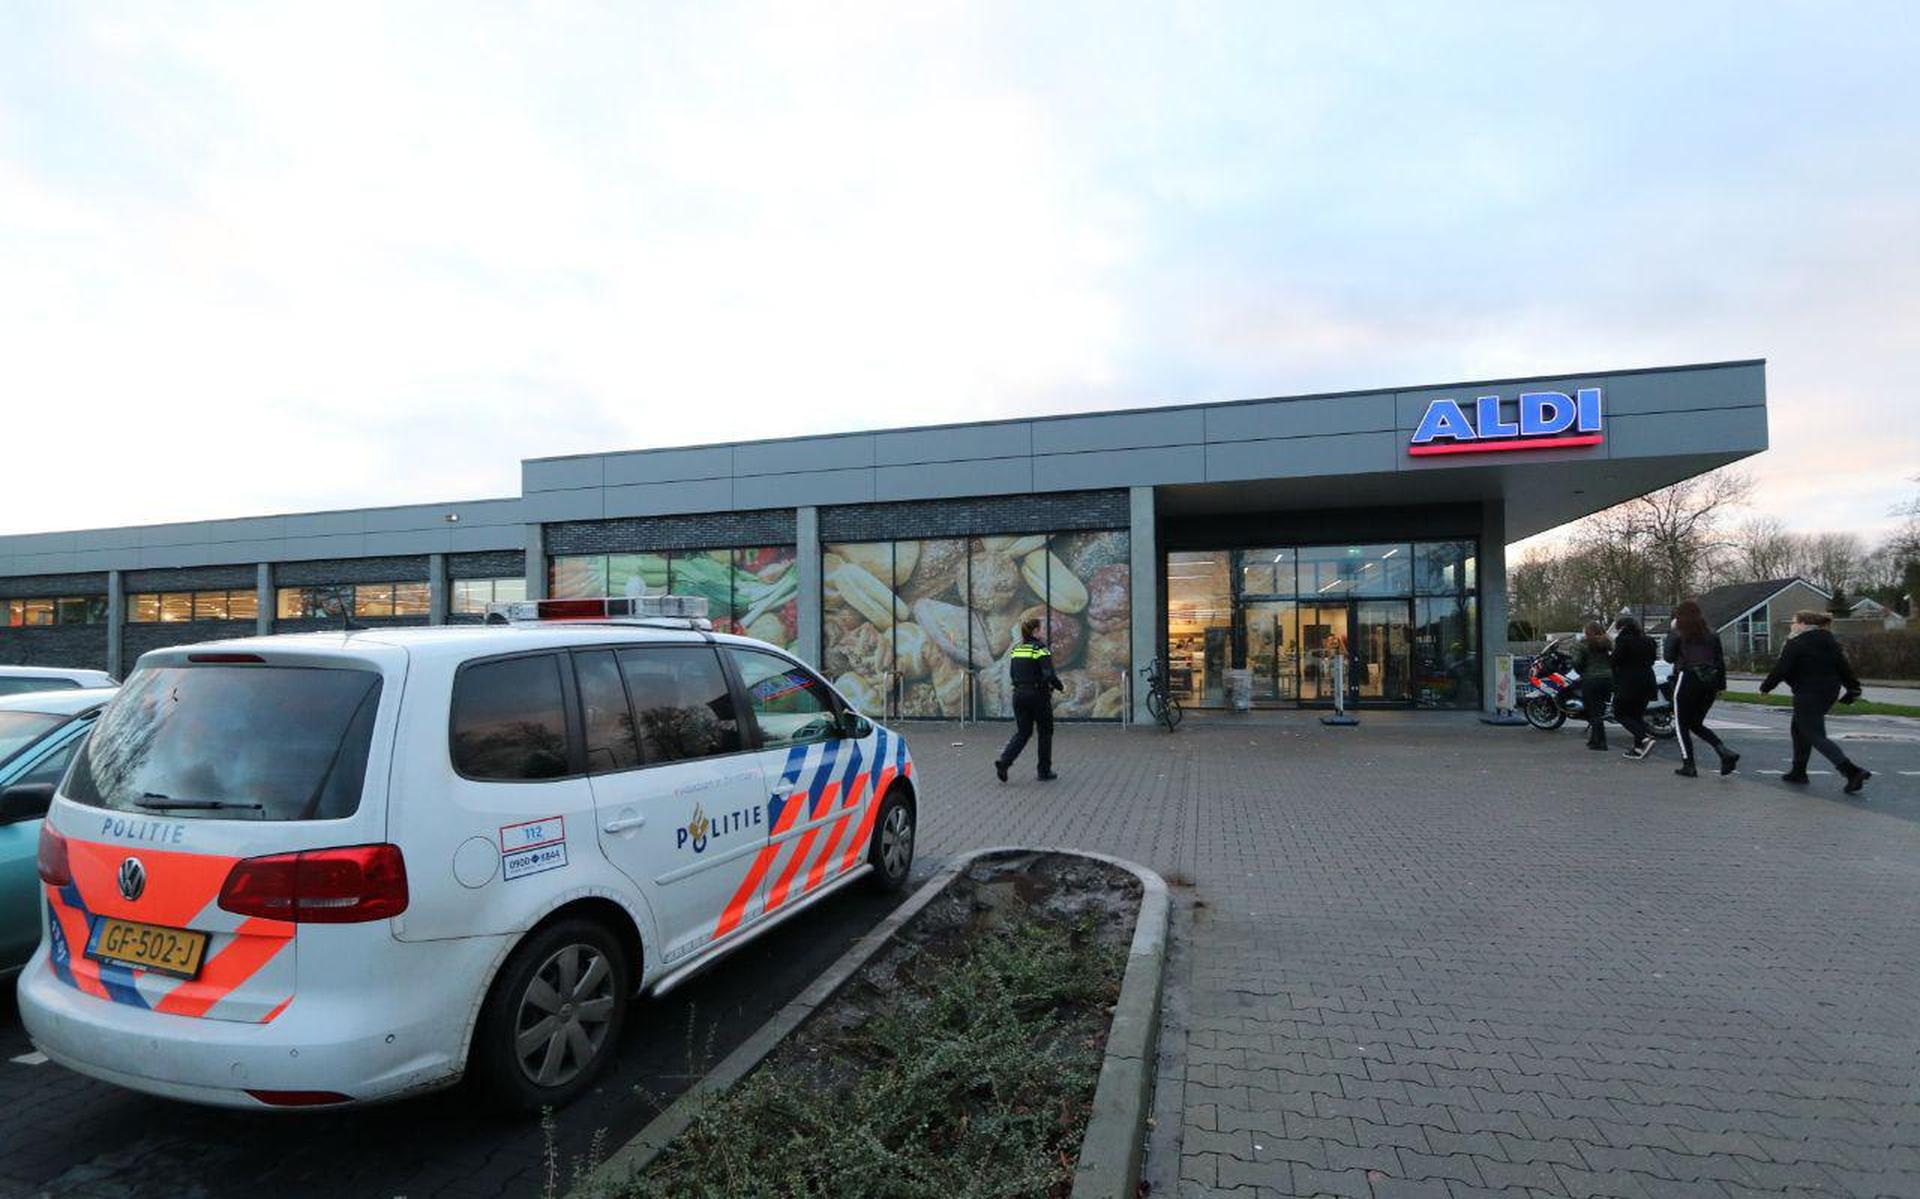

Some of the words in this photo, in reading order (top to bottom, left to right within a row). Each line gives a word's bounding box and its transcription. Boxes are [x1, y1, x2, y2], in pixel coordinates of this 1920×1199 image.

[1411, 387, 1602, 443] ALDI
[102, 818, 185, 843] POLITIE
[525, 826, 543, 840] 112
[677, 805, 762, 853] POLITIE
[107, 924, 194, 966] GF-502-J
